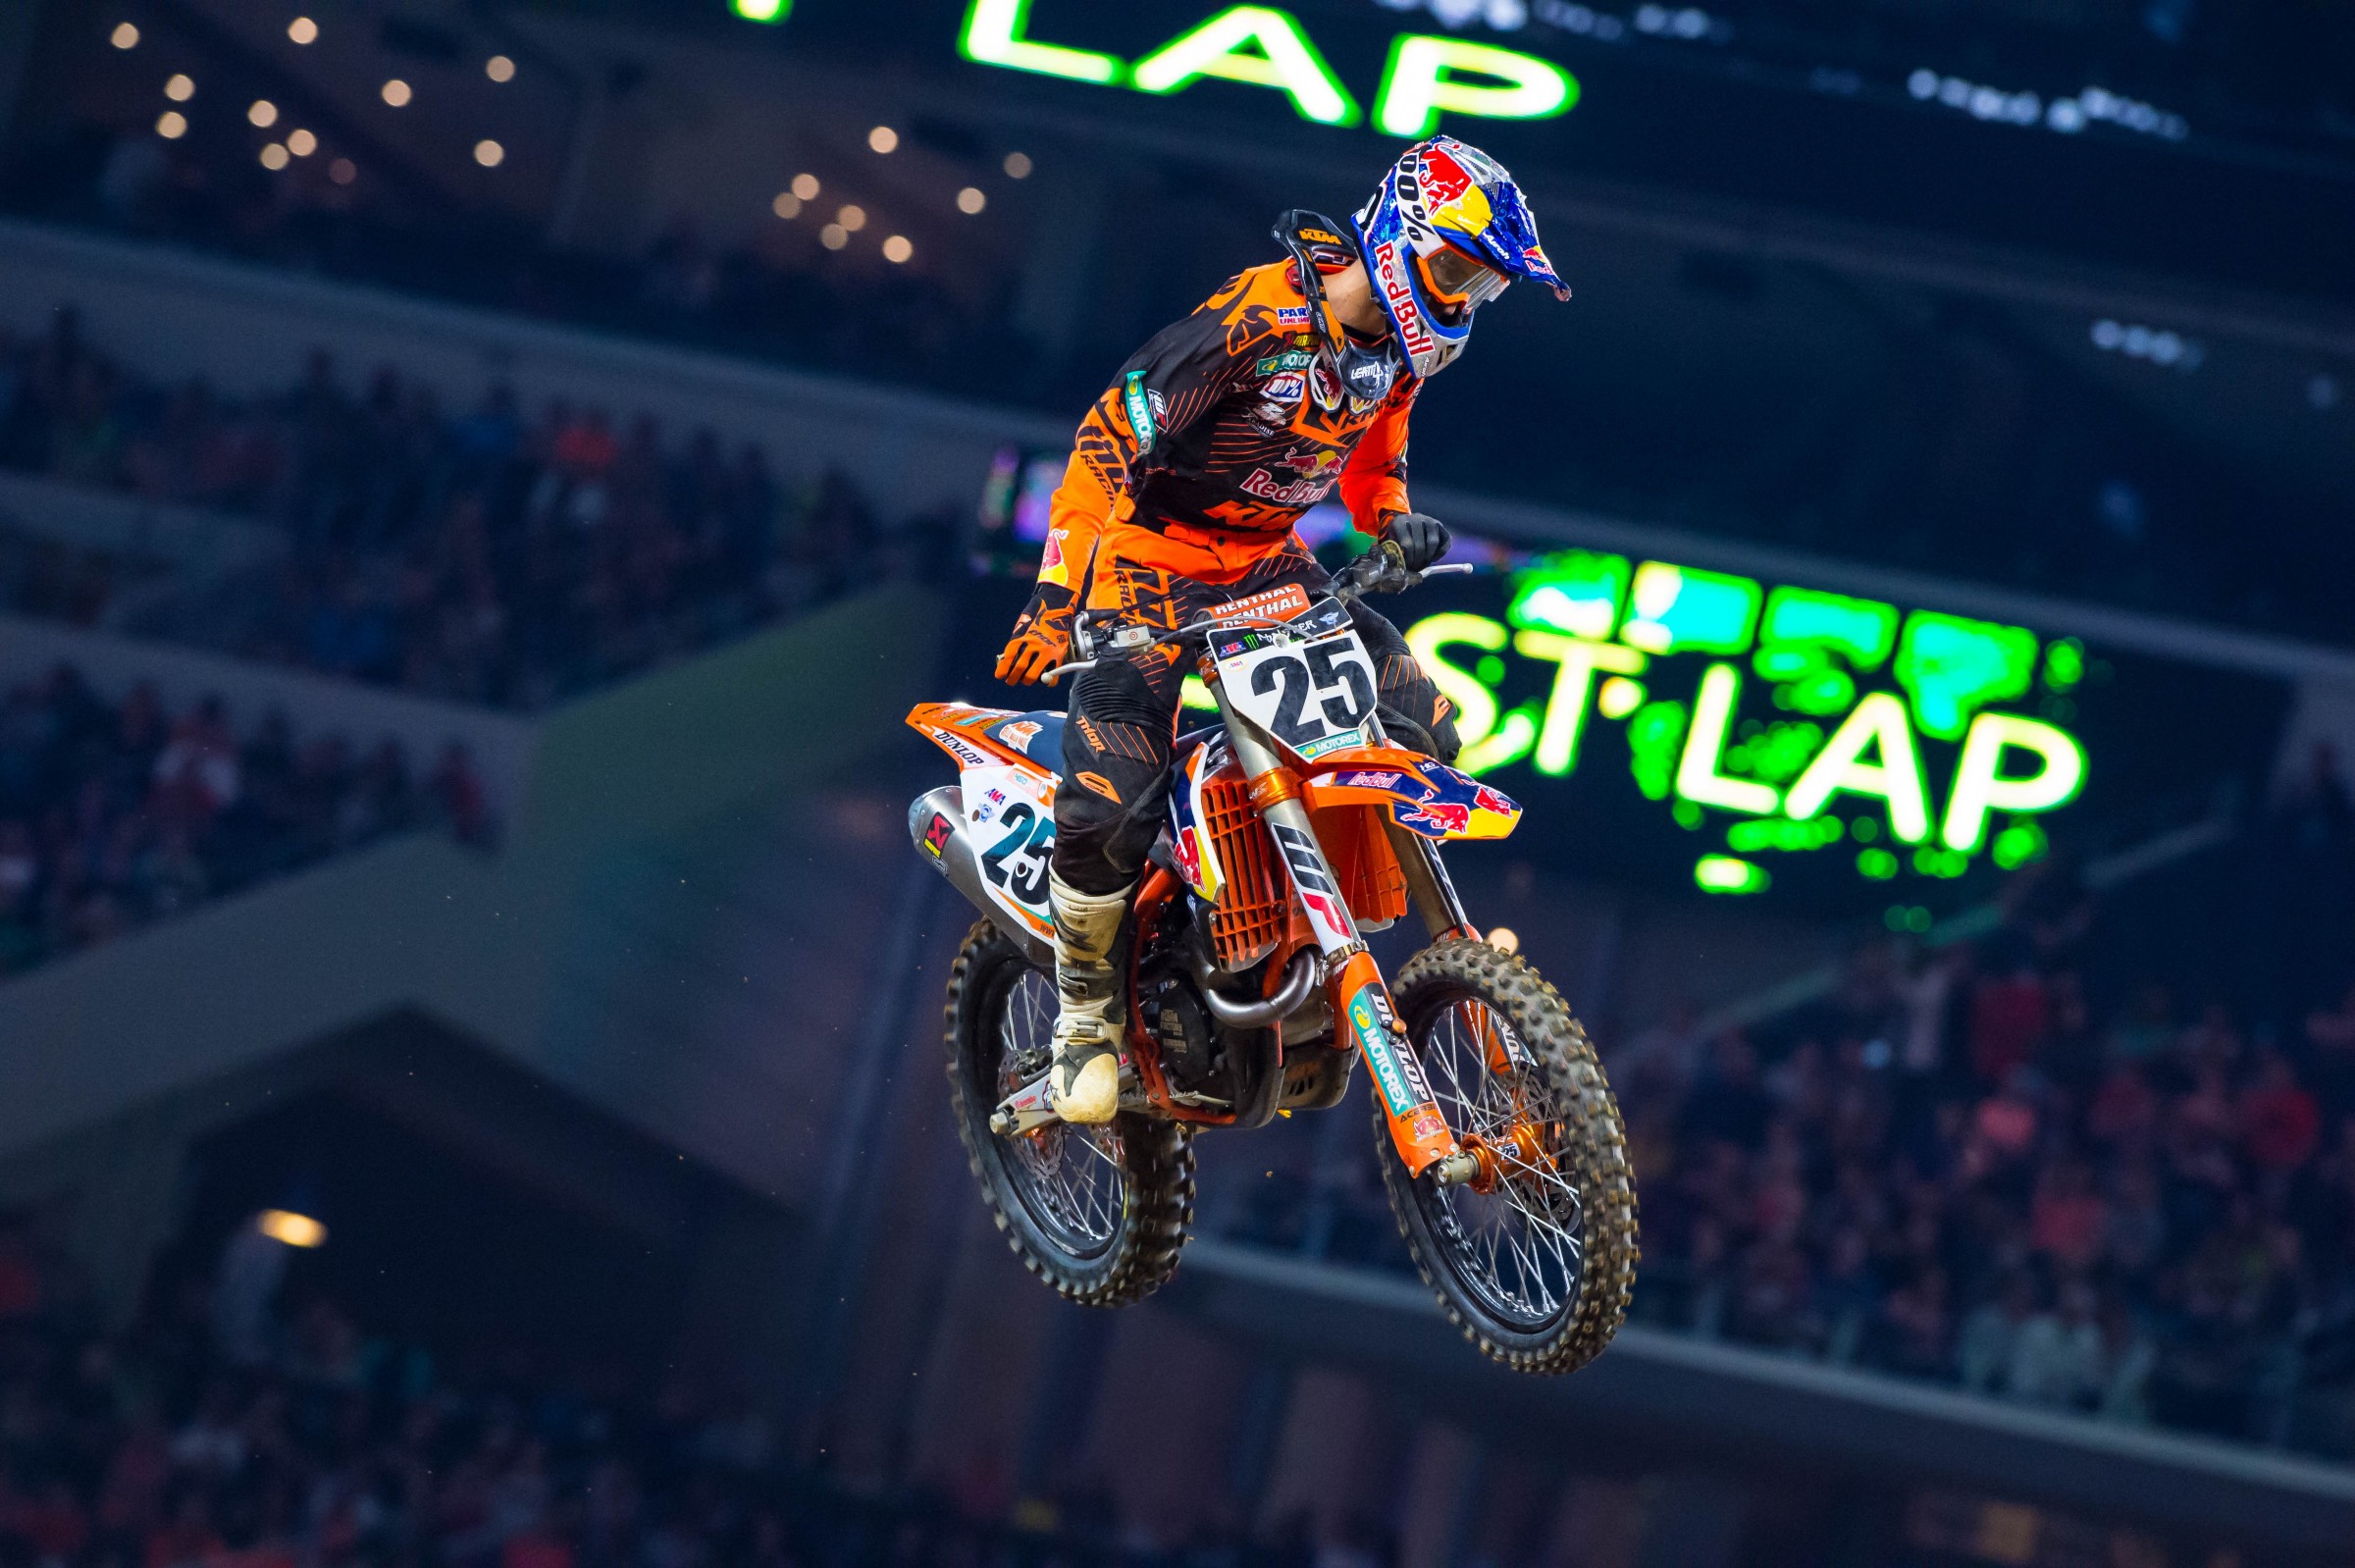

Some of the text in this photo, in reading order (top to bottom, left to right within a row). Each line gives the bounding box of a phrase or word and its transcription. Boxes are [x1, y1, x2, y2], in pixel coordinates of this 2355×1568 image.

[958, 0, 1579, 140] LAP
[1397, 154, 1436, 242] 00%
[1298, 228, 1342, 245] KTM
[1375, 240, 1435, 357] Red Bull
[1239, 467, 1301, 504] Red
[1215, 584, 1297, 616] RENTHAL
[1219, 641, 1247, 658] AMA
[1250, 636, 1371, 749] 25
[934, 731, 985, 766] DUNLOP
[1075, 714, 1107, 755] THOR
[1316, 732, 1362, 753] MOTOREX
[1676, 662, 2090, 854] LAP
[983, 787, 1008, 807] AMA
[981, 802, 1058, 906] 25
[1363, 1026, 1410, 1112] MOTOREX
